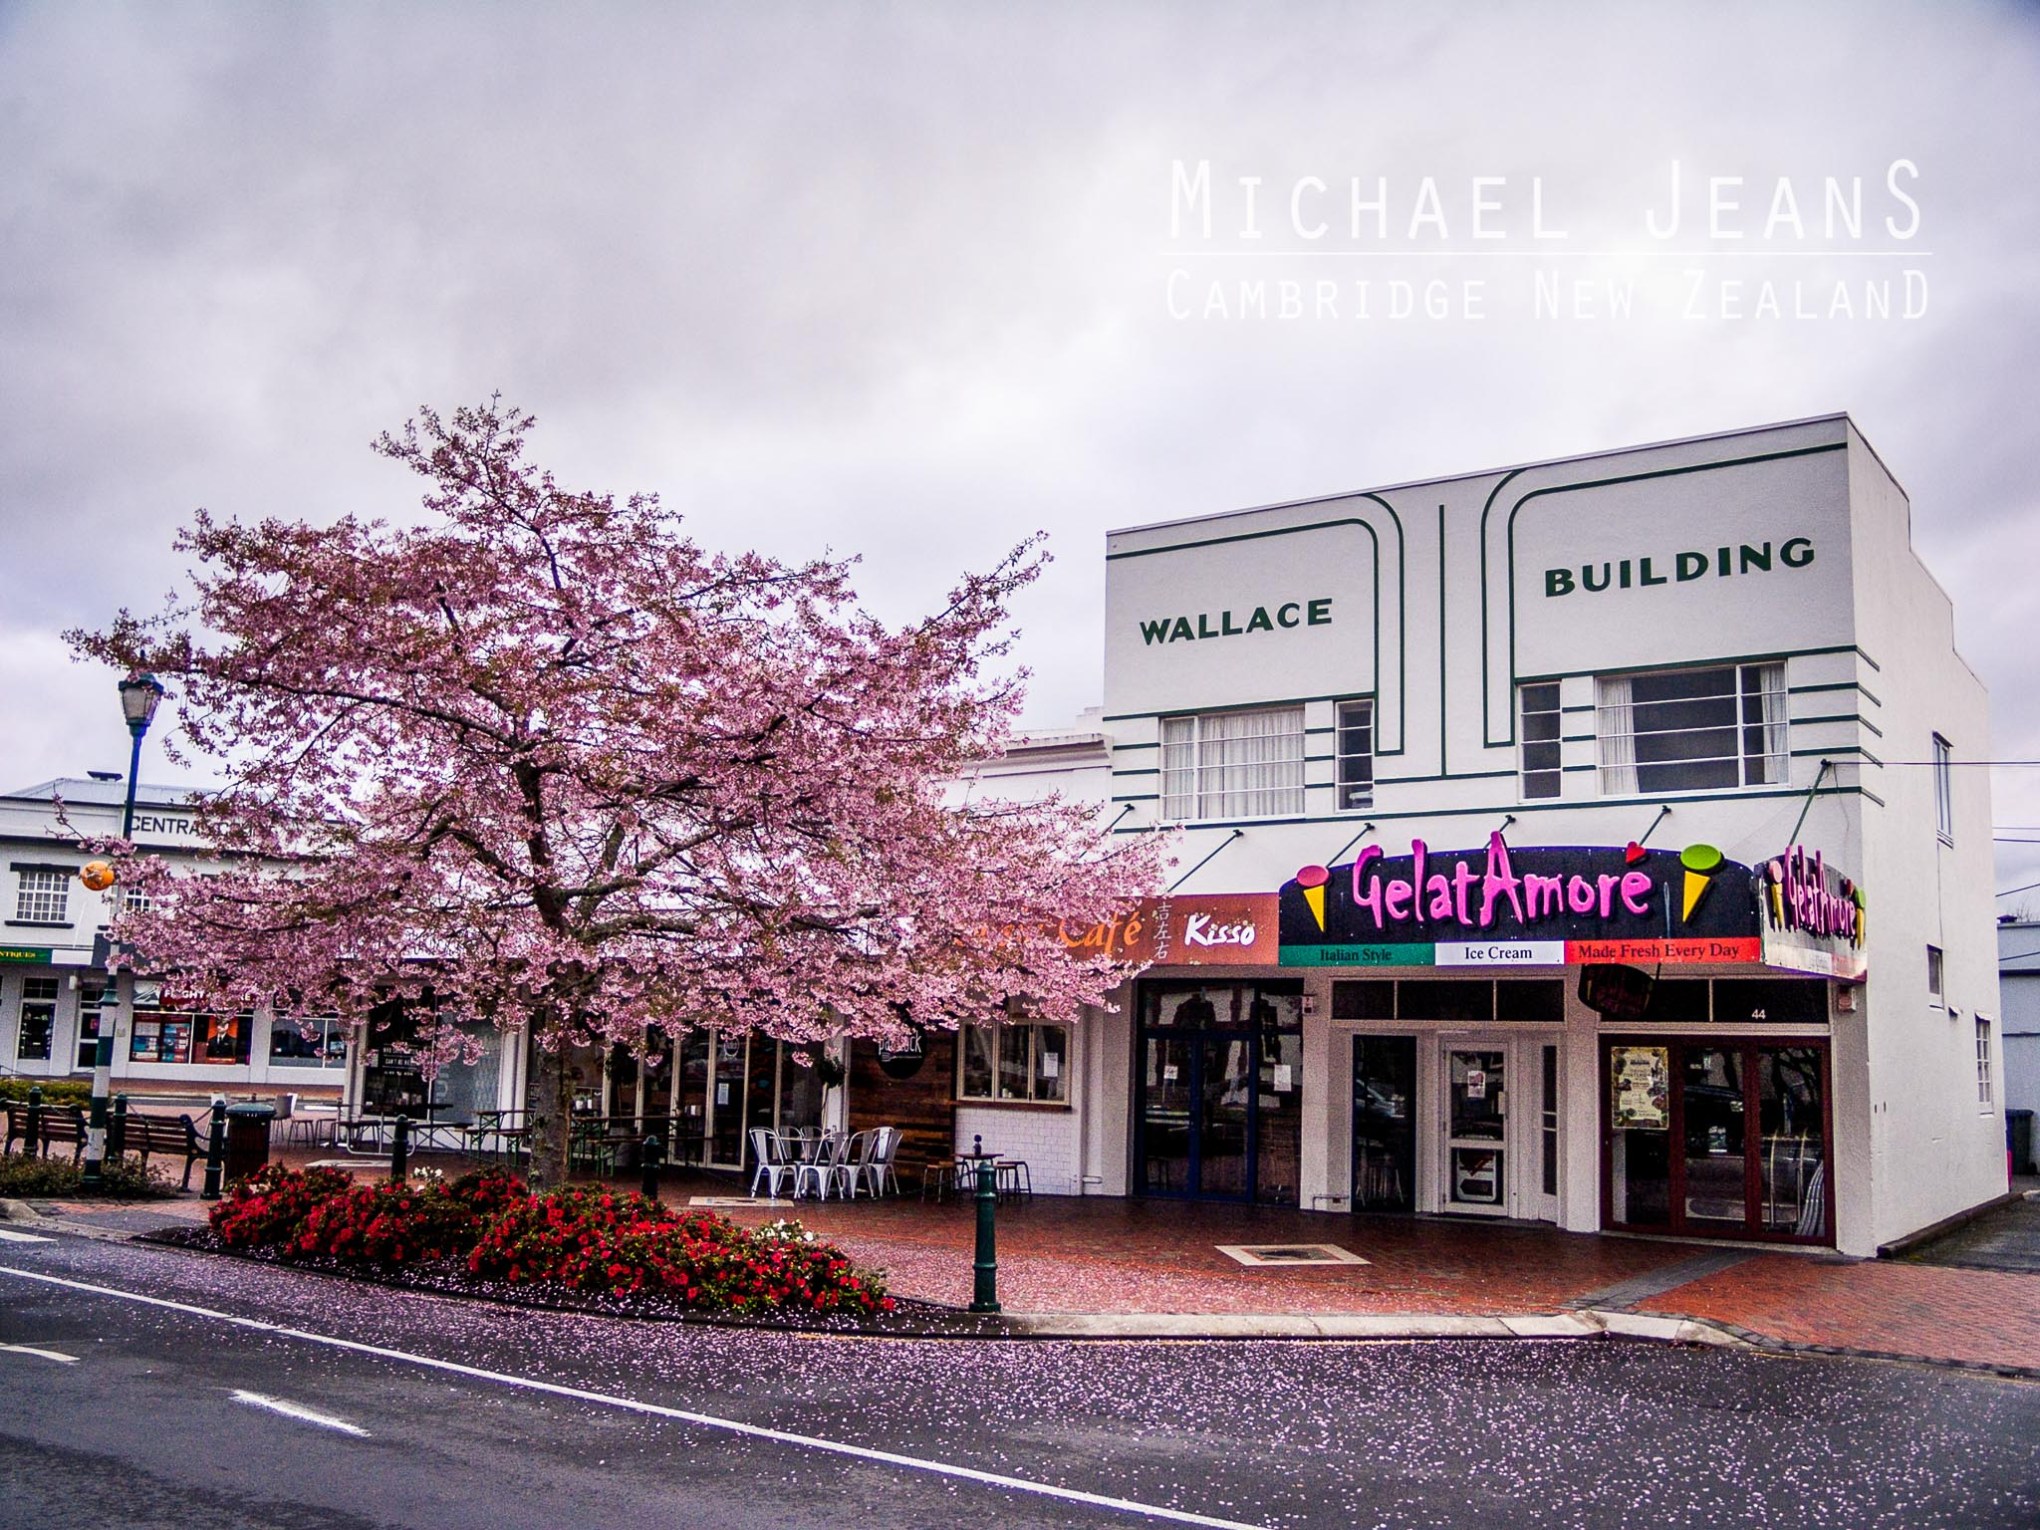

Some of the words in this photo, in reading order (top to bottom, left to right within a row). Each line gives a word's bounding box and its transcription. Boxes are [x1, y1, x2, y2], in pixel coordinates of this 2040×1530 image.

[1140, 599, 1333, 645] WALLACE
[1546, 538, 1815, 597] BUILDING
[131, 815, 206, 835] CENTRA
[1184, 914, 1255, 946] Kisso
[1320, 949, 1359, 961] Italian
[1362, 948, 1393, 962] Style
[1465, 947, 1484, 959] Ice
[1488, 946, 1533, 959] Cream
[1579, 945, 1616, 958] Made
[1620, 944, 1660, 957] Fresh
[1665, 944, 1705, 958] Every
[1710, 943, 1739, 958] Day
[1751, 1009, 1766, 1020] 44
